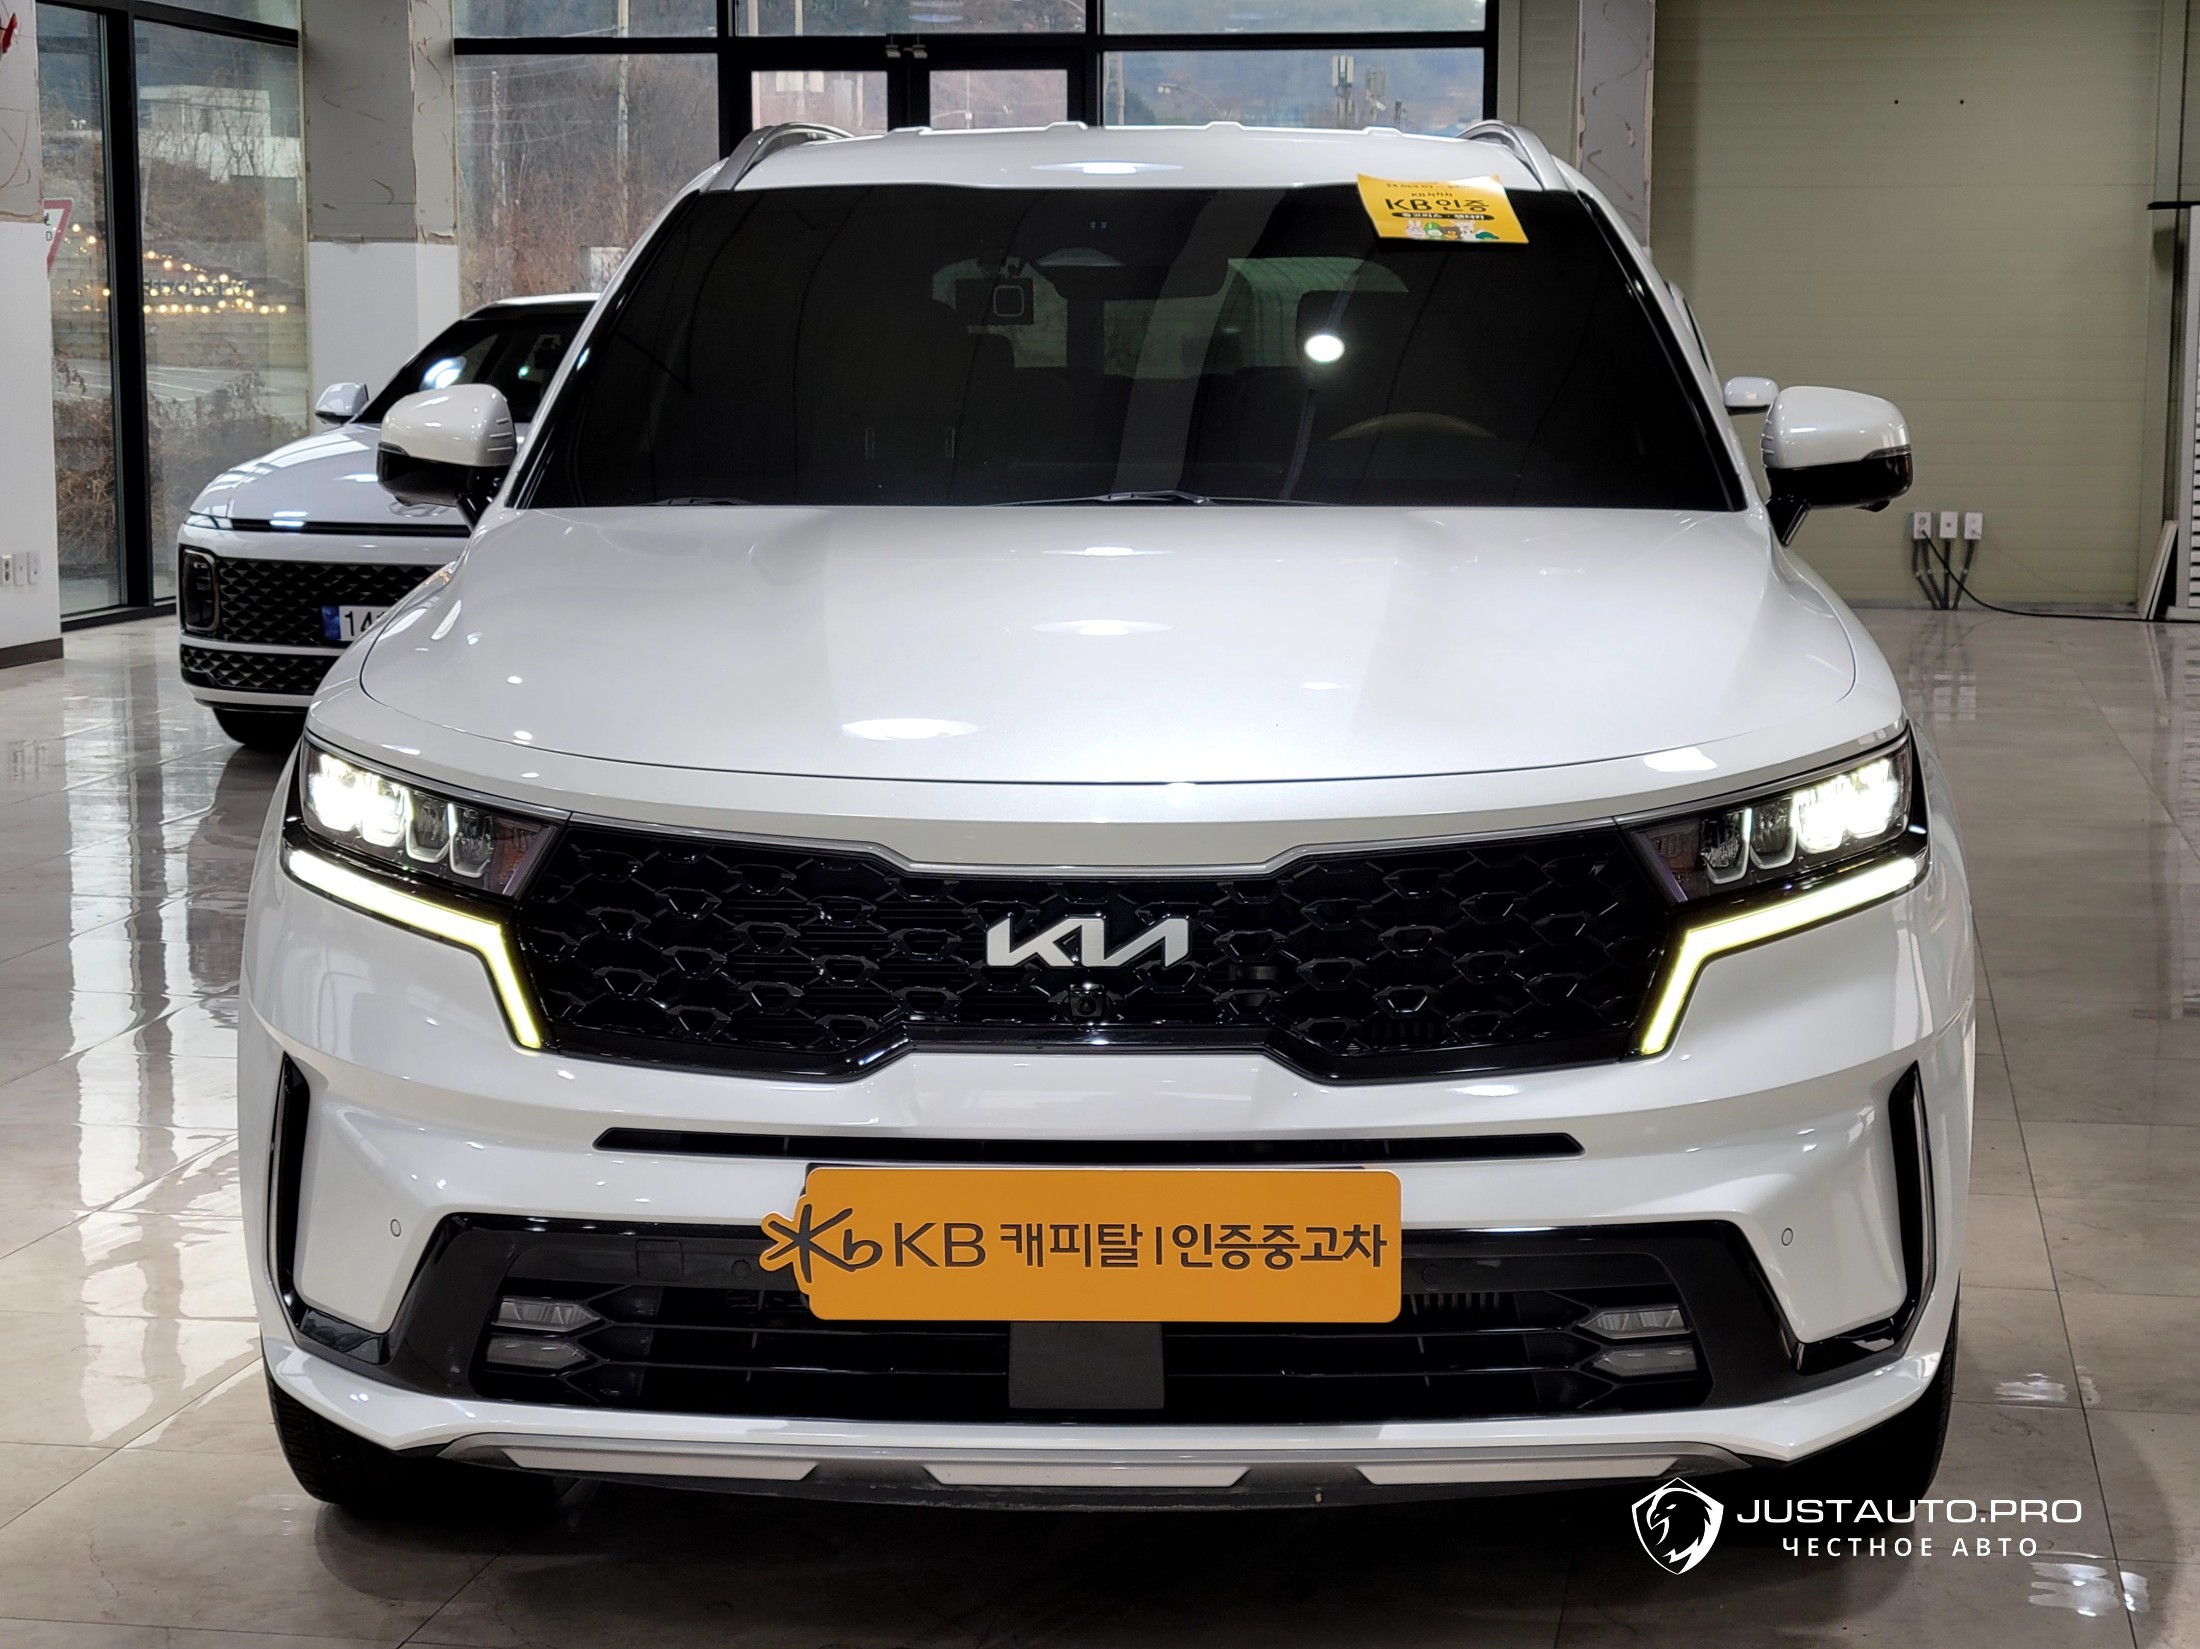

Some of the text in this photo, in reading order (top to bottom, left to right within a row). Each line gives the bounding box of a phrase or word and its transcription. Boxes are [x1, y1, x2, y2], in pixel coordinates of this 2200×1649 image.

[344, 610, 385, 637] 14
[986, 914, 1190, 968] KIA
[894, 1222, 986, 1268] KB
[999, 1222, 1145, 1269] 캐피탈
[1171, 1222, 1388, 1271] 인증중고차
